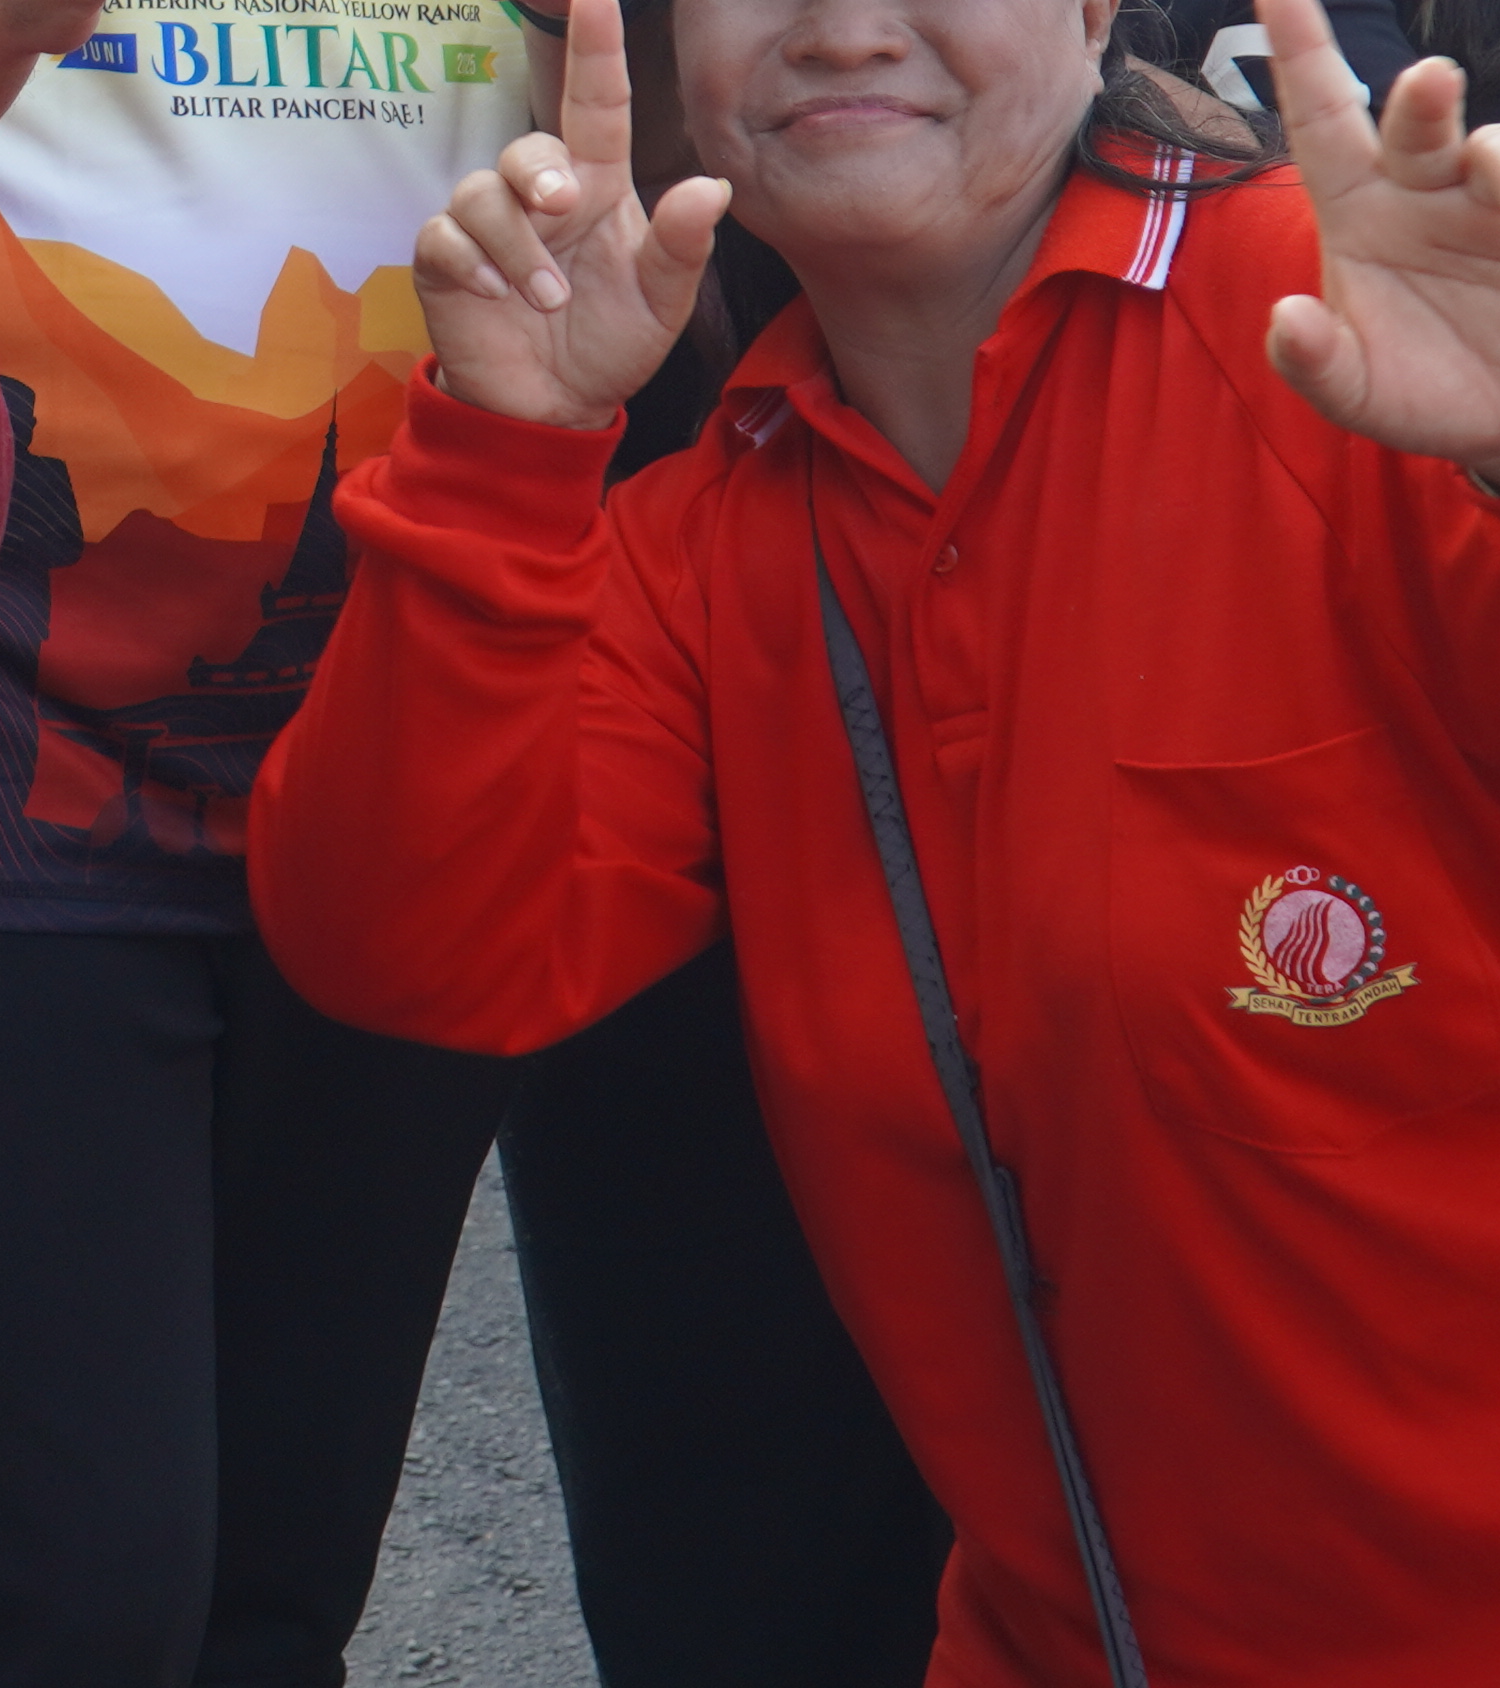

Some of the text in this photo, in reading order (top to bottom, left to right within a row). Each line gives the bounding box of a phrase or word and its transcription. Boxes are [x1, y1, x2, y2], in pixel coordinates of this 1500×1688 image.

[417, 3, 481, 26] RANGER
[81, 40, 125, 66] JUNI
[151, 20, 436, 94] BLITAR
[170, 96, 266, 118] BLITAR
[272, 97, 377, 120] PANCEN
[1306, 982, 1344, 994] TERA
[1252, 979, 1399, 1024] SEHAT TENTRAM INDAH
